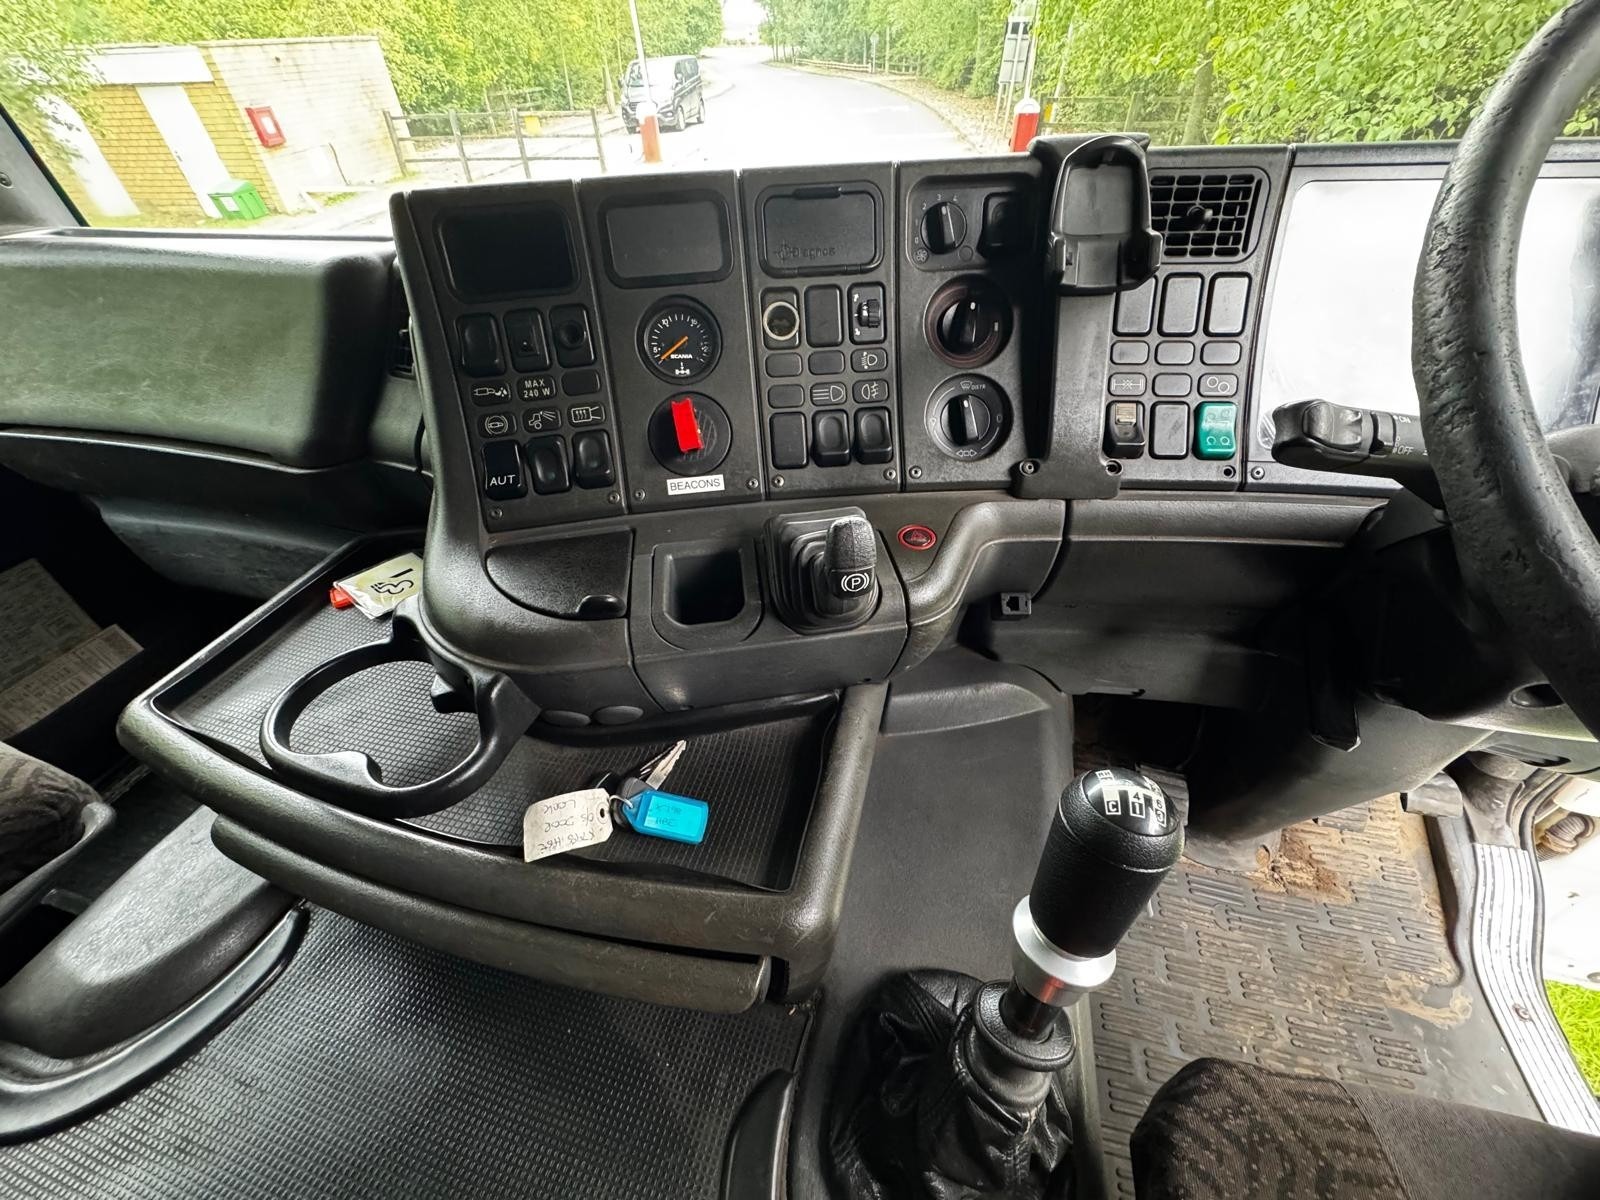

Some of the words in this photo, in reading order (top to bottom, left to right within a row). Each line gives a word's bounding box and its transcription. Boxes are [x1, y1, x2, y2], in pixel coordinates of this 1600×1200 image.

[524, 379, 545, 388] MAX
[523, 389, 539, 398] 240
[542, 387, 550, 396] W
[489, 474, 516, 487] AUT
[669, 478, 721, 491] BEACONS
